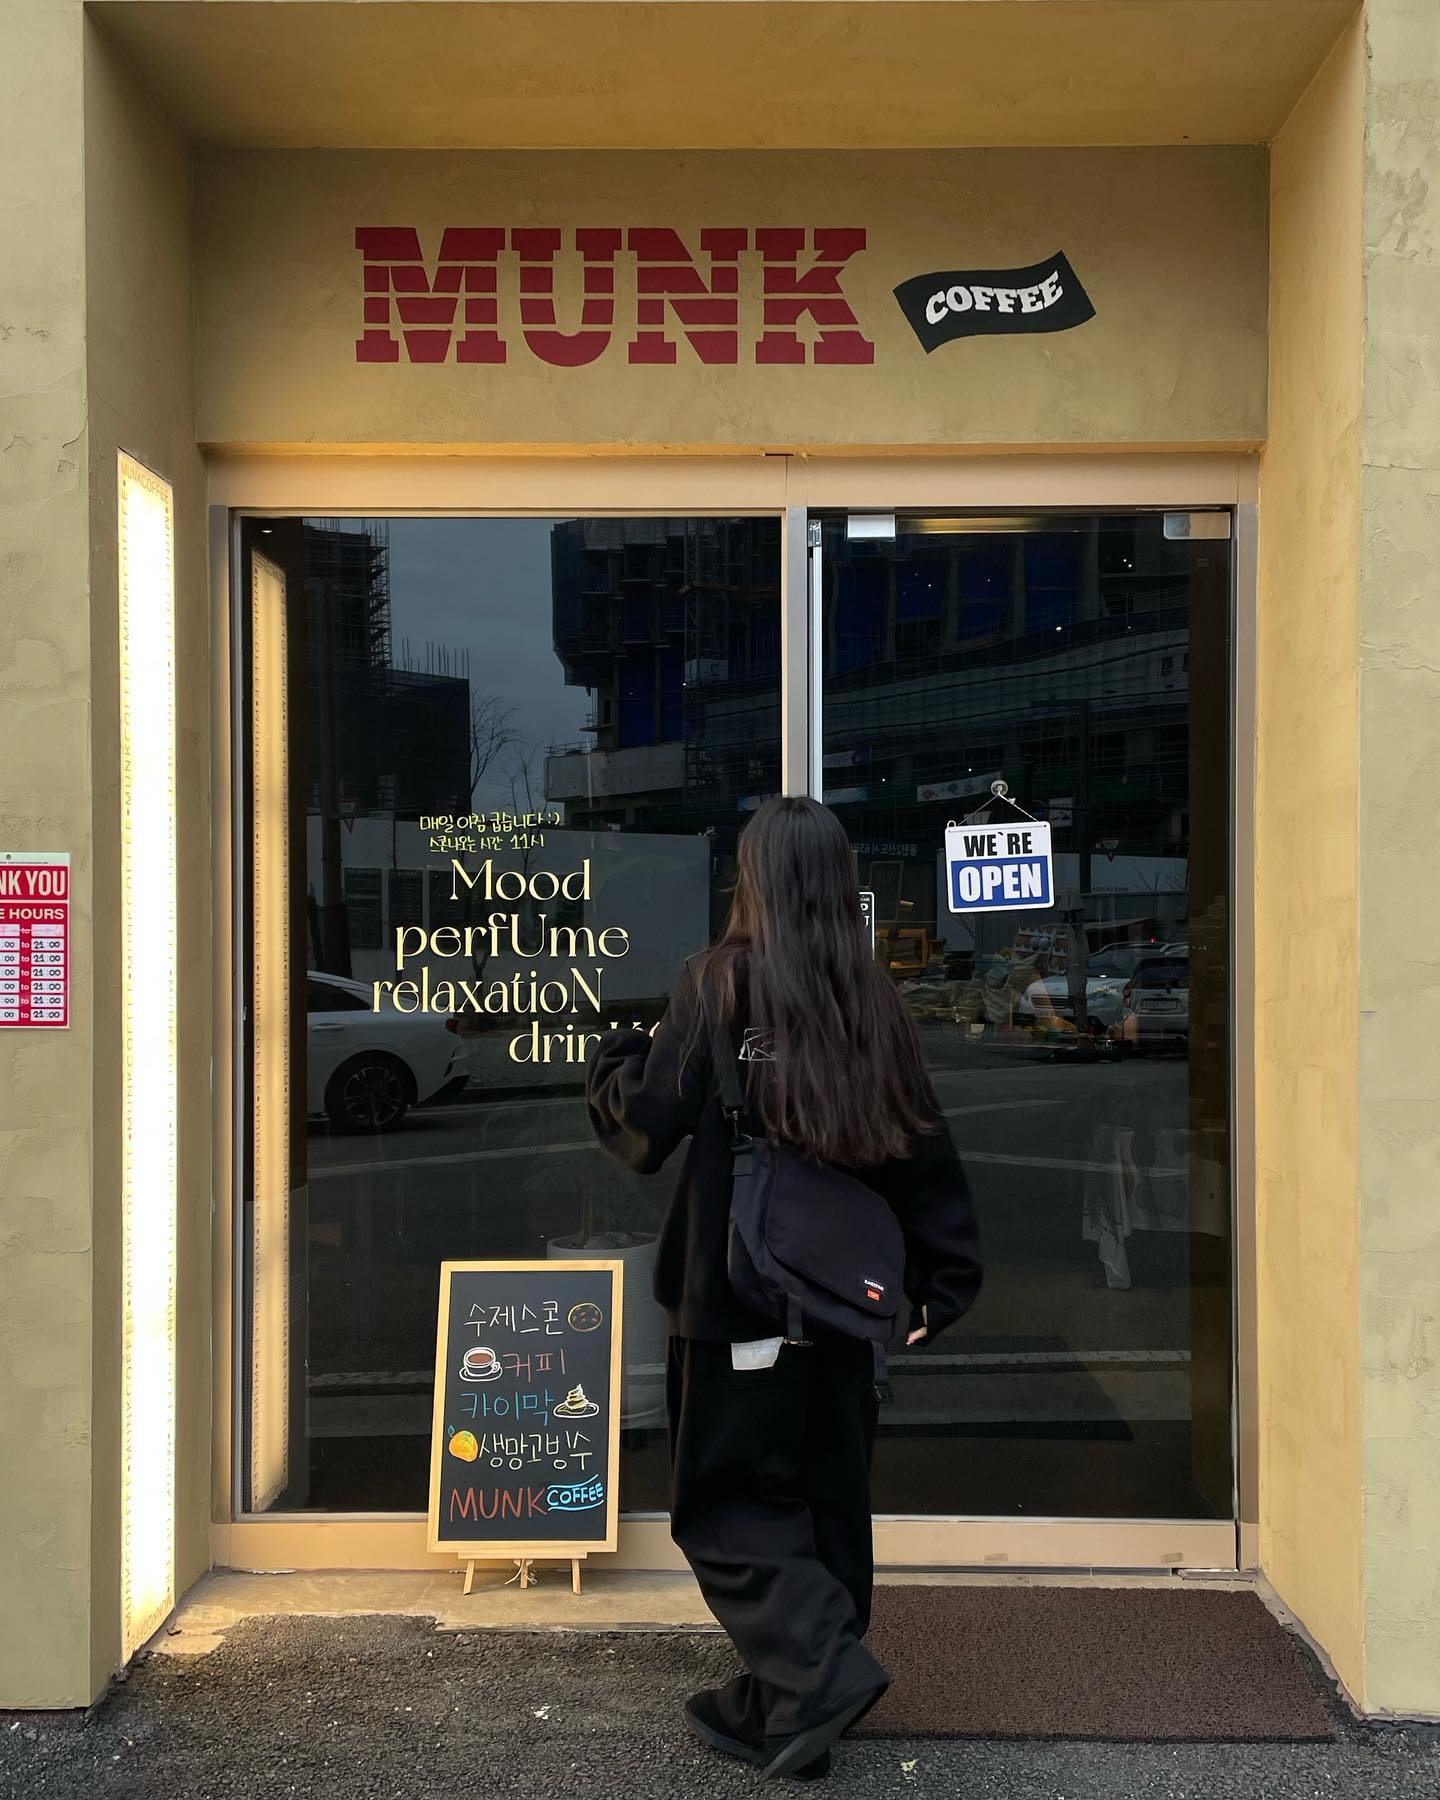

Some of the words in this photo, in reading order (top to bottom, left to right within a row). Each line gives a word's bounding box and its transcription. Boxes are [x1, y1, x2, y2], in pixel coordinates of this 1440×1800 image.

[356, 227, 876, 367] MUNK
[925, 270, 1063, 324] COFFEE
[419, 814, 454, 833] 매일
[456, 811, 486, 833] 아침
[480, 836, 503, 851] 시간
[510, 833, 544, 850] 11시
[25, 870, 66, 896] YOU
[450, 858, 591, 901] Mood
[958, 862, 1043, 902] OPEN
[9, 908, 65, 920] HOURS
[395, 912, 630, 971] perfUme
[372, 966, 604, 1014] relaxatioN
[464, 1301, 563, 1337] 수제스콘
[502, 1348, 566, 1382] 커피
[460, 1388, 555, 1426] 카이막
[479, 1430, 592, 1470] 생망고빙수
[450, 1486, 548, 1522] MUNK
[546, 1482, 603, 1506] COFFEE
